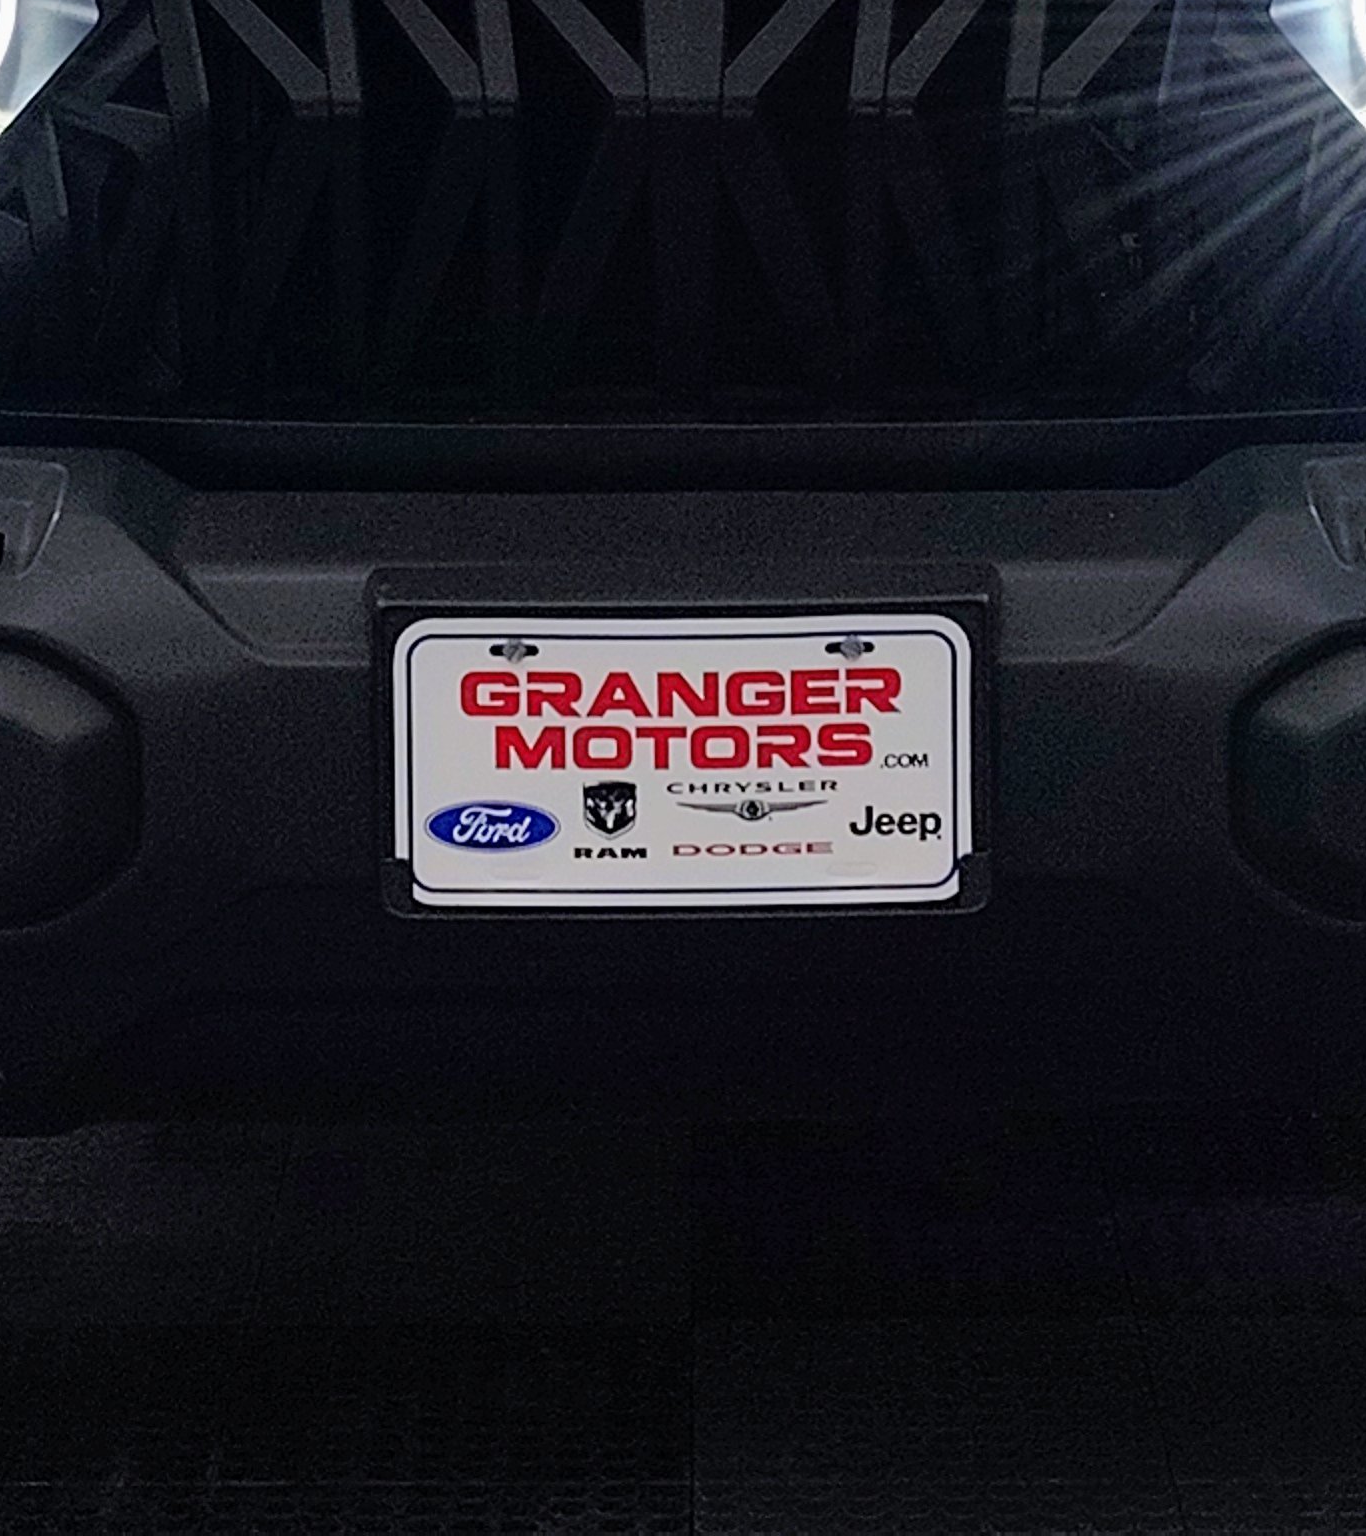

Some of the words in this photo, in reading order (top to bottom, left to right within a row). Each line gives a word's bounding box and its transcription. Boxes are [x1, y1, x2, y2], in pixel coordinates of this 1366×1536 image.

[459, 667, 903, 719] GRANGER
[493, 722, 875, 771] MOTORS
[880, 752, 930, 769] .COM
[666, 779, 839, 795] CHRYSLER
[452, 806, 532, 844] Ford
[848, 805, 943, 842] Jeep
[573, 847, 648, 859] RAM
[672, 840, 835, 857] DODGE
